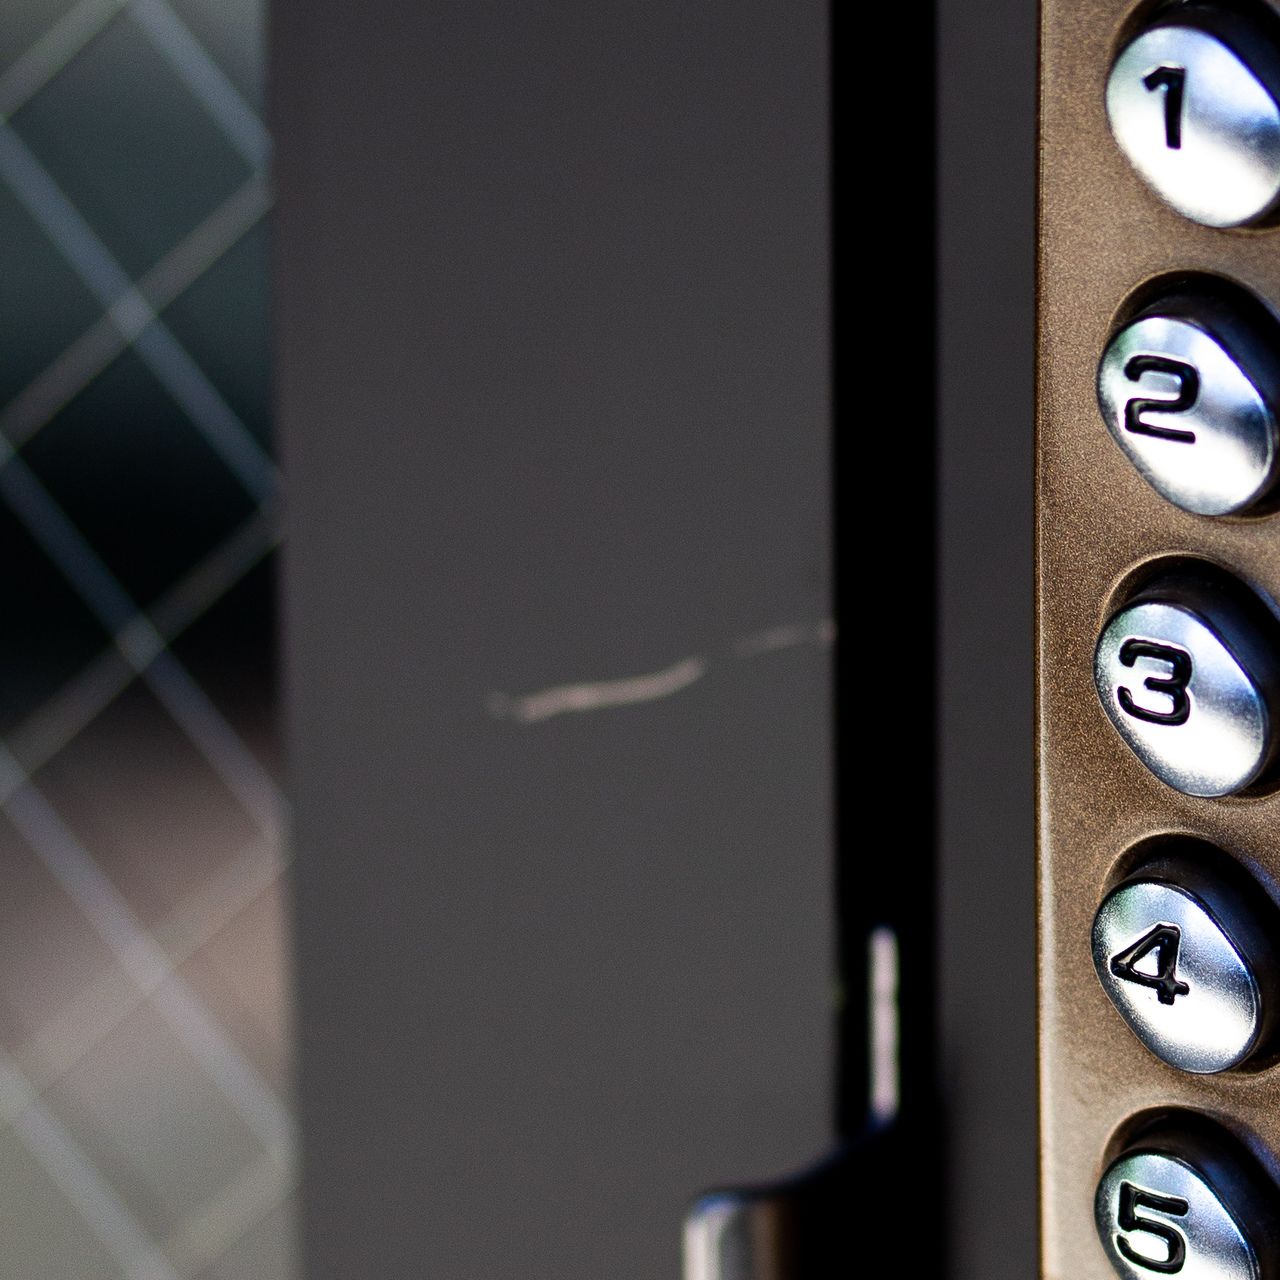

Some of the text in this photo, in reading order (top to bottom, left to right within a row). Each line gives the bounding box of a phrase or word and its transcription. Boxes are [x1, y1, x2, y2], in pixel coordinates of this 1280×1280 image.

[1142, 65, 1187, 150] 1
[1123, 353, 1201, 445] 2
[1116, 637, 1194, 727] 3
[1110, 922, 1191, 1006] 4
[1114, 1181, 1190, 1275] 5
